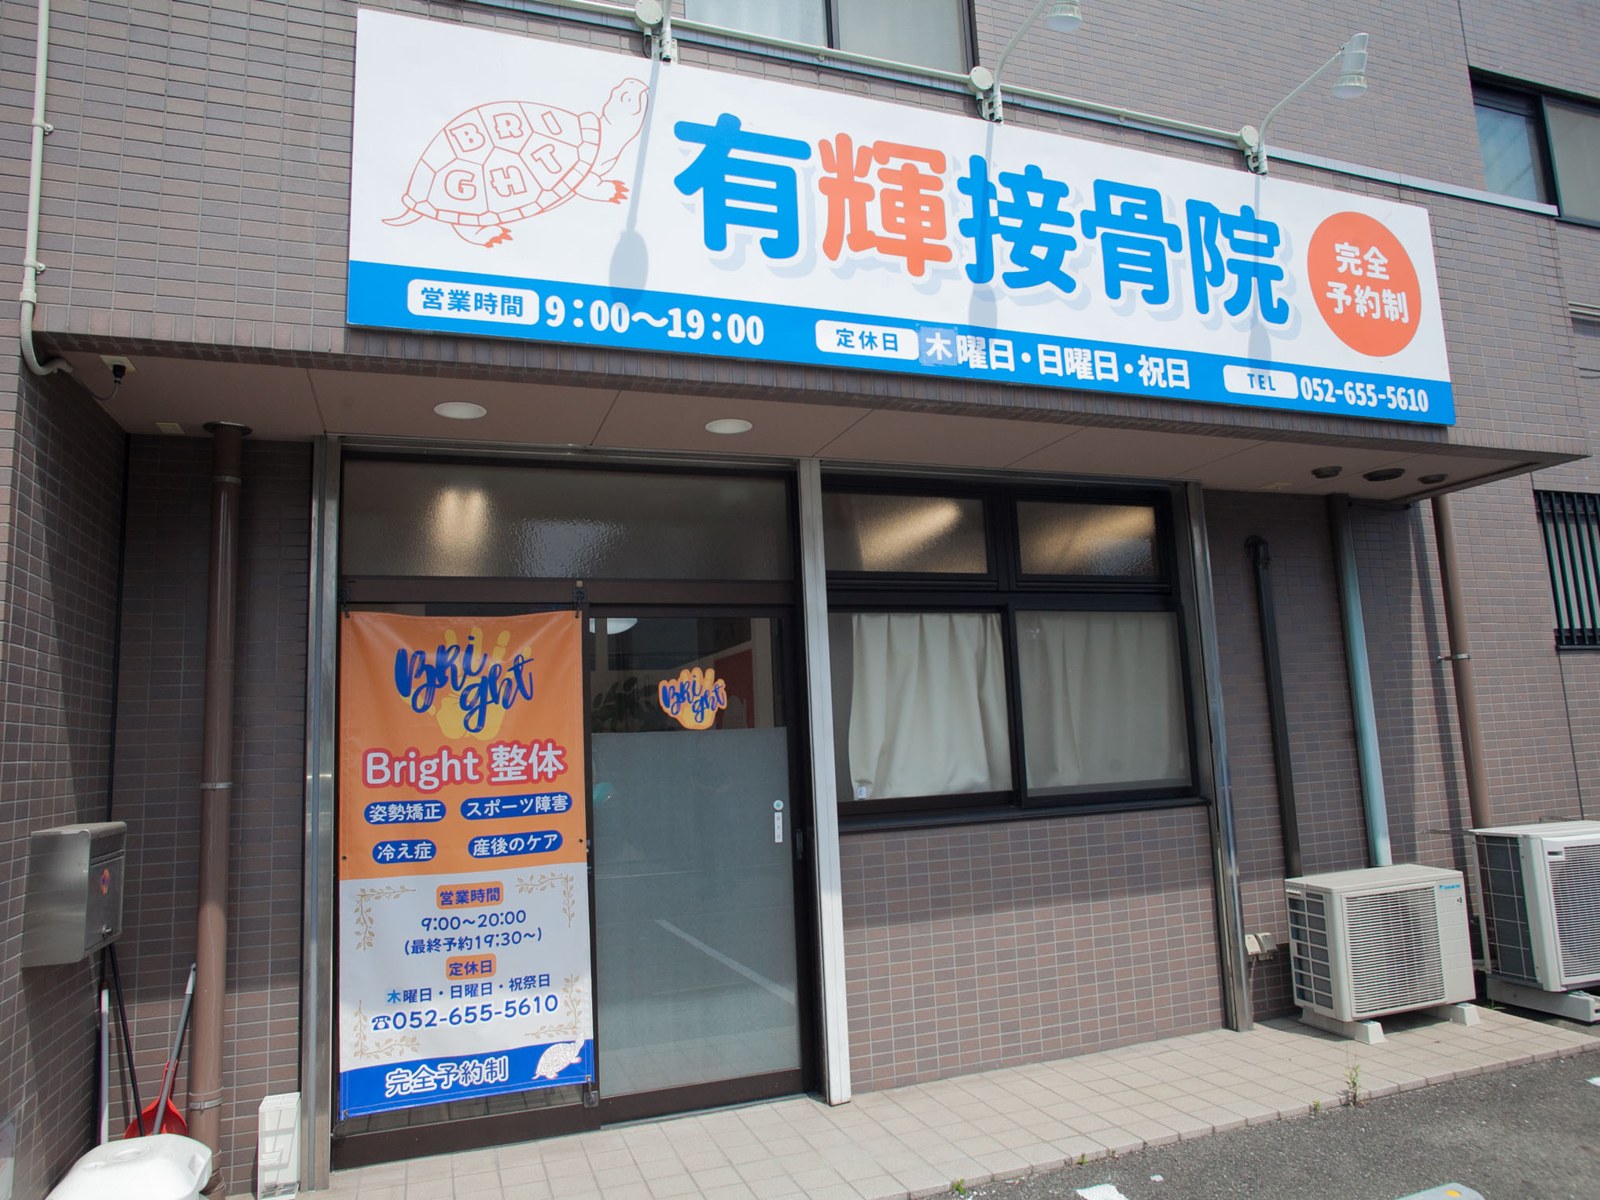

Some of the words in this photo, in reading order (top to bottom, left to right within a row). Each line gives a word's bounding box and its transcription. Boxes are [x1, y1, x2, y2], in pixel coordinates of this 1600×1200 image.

[448, 111, 563, 153] BRI
[444, 144, 565, 202] GHT
[673, 112, 1290, 325] 有輝接骨院
[1335, 241, 1390, 280] 完全
[421, 286, 525, 318] 営業時間
[1326, 281, 1408, 323] 予約制
[835, 327, 900, 353] 定休日
[1246, 372, 1278, 393] TEL
[1300, 376, 1430, 413] 052-655-5610
[366, 744, 480, 791] Bright
[490, 742, 565, 784] 整体
[369, 803, 443, 822] 姿勢矯正
[466, 795, 569, 817] スポーツ障害
[376, 842, 433, 862] 冷え症
[473, 833, 559, 857] 産後のケア
[439, 886, 501, 907] 営業時間
[449, 960, 493, 977] 定休日
[385, 1056, 509, 1098] 完全予約制
